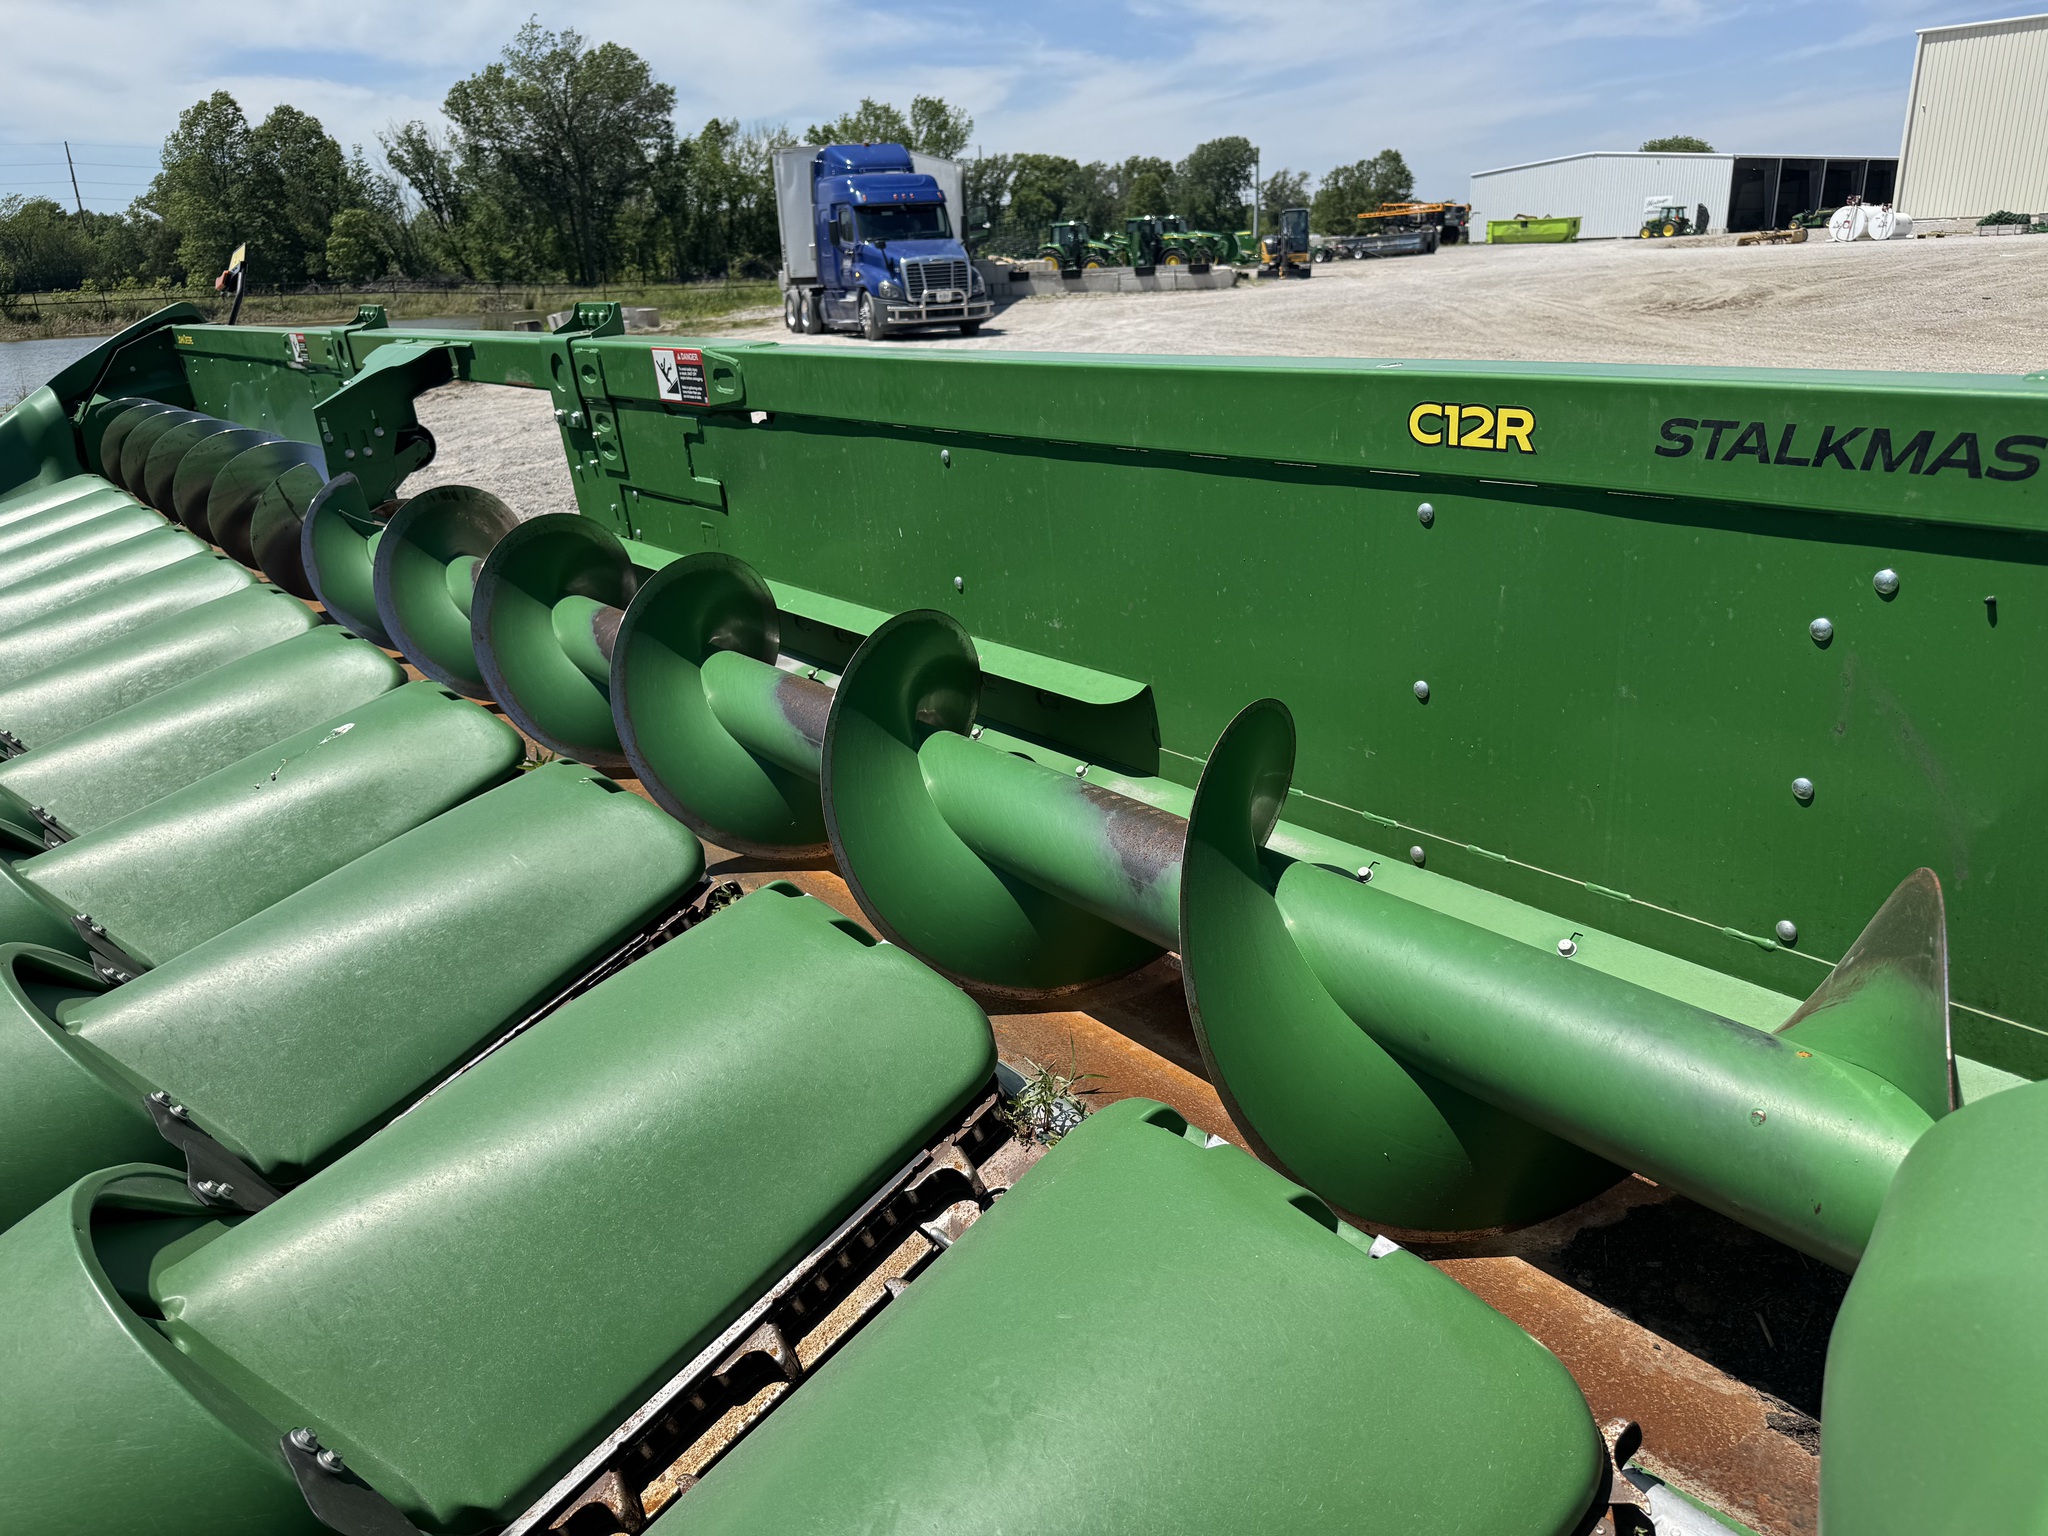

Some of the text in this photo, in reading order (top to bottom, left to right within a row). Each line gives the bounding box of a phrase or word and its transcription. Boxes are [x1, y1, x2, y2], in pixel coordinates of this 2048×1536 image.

[681, 352, 699, 361] DANGER
[1408, 401, 1537, 455] C12R
[1654, 417, 2048, 482] STALKMAS
